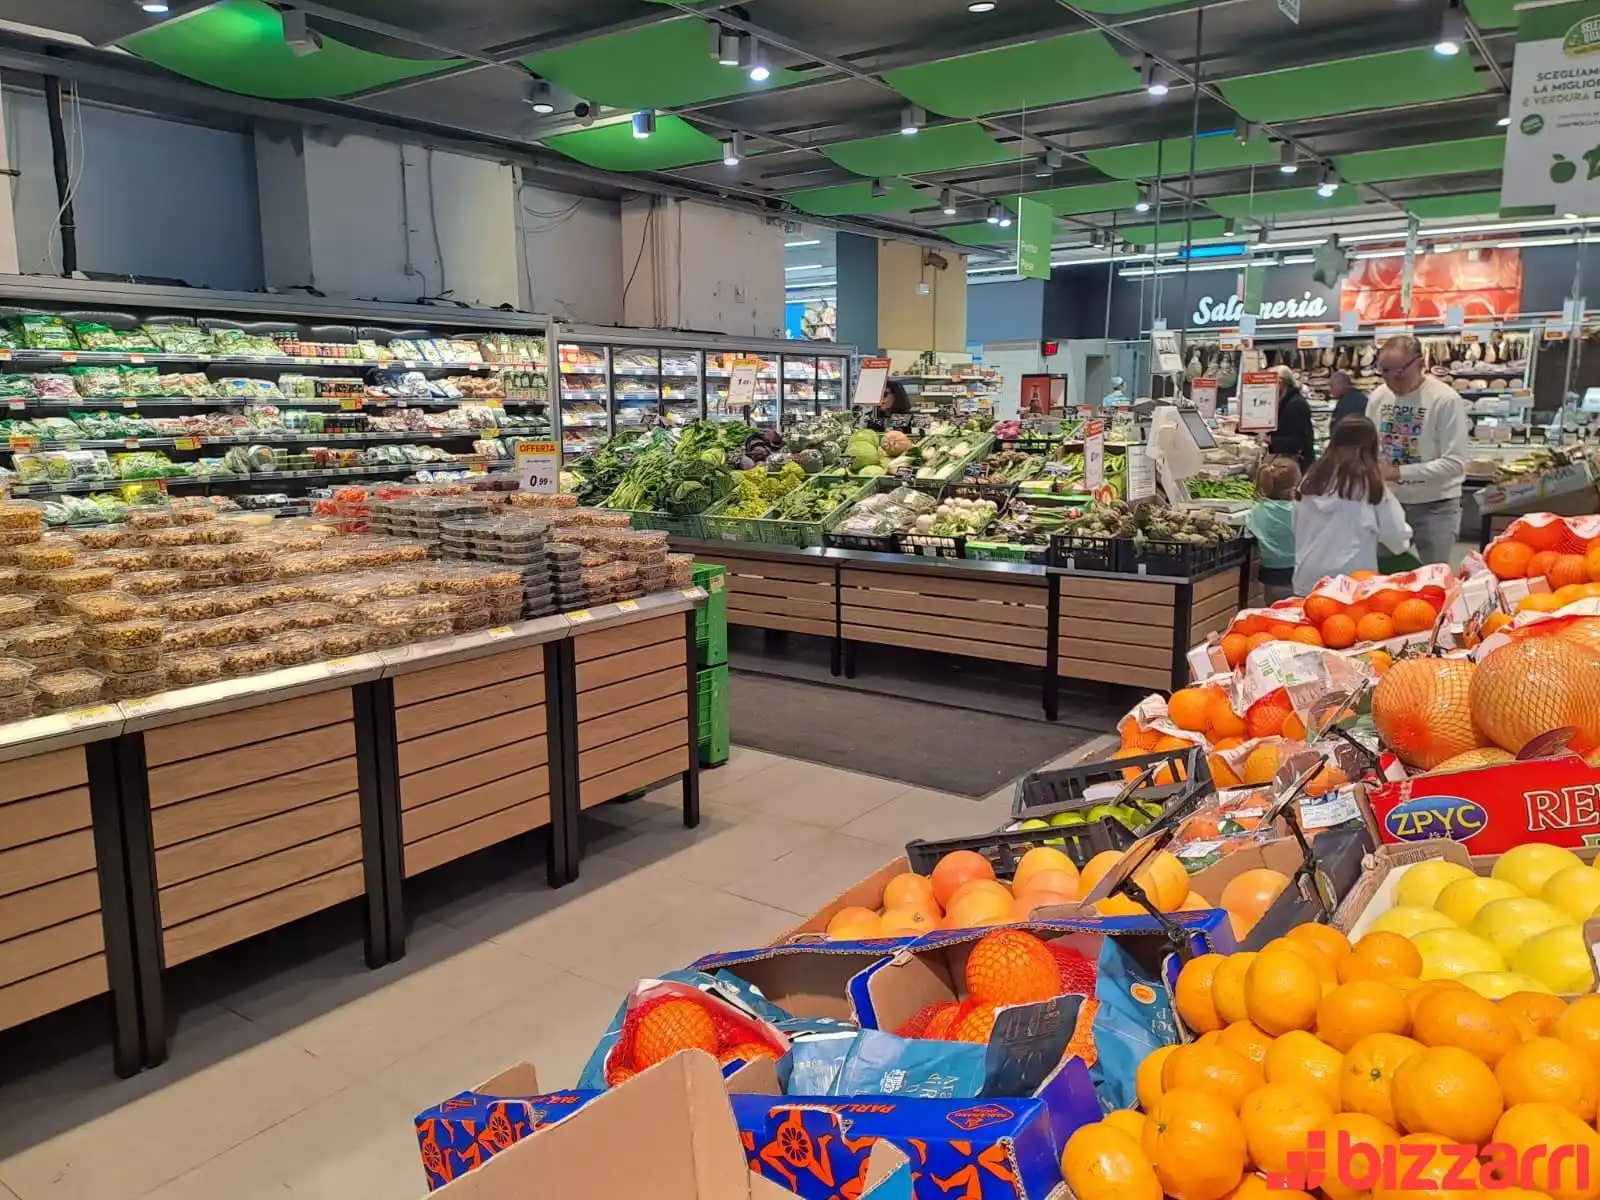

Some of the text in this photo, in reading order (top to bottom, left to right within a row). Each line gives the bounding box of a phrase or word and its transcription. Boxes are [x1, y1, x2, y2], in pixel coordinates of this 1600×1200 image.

[1533, 85, 1548, 94] LA
[1533, 92, 1590, 106] VERDURA
[1192, 291, 1328, 325] Salmeria
[519, 444, 555, 453] OFFERTA
[1523, 783, 1600, 831] RE
[1391, 805, 1481, 836] ZPYC
